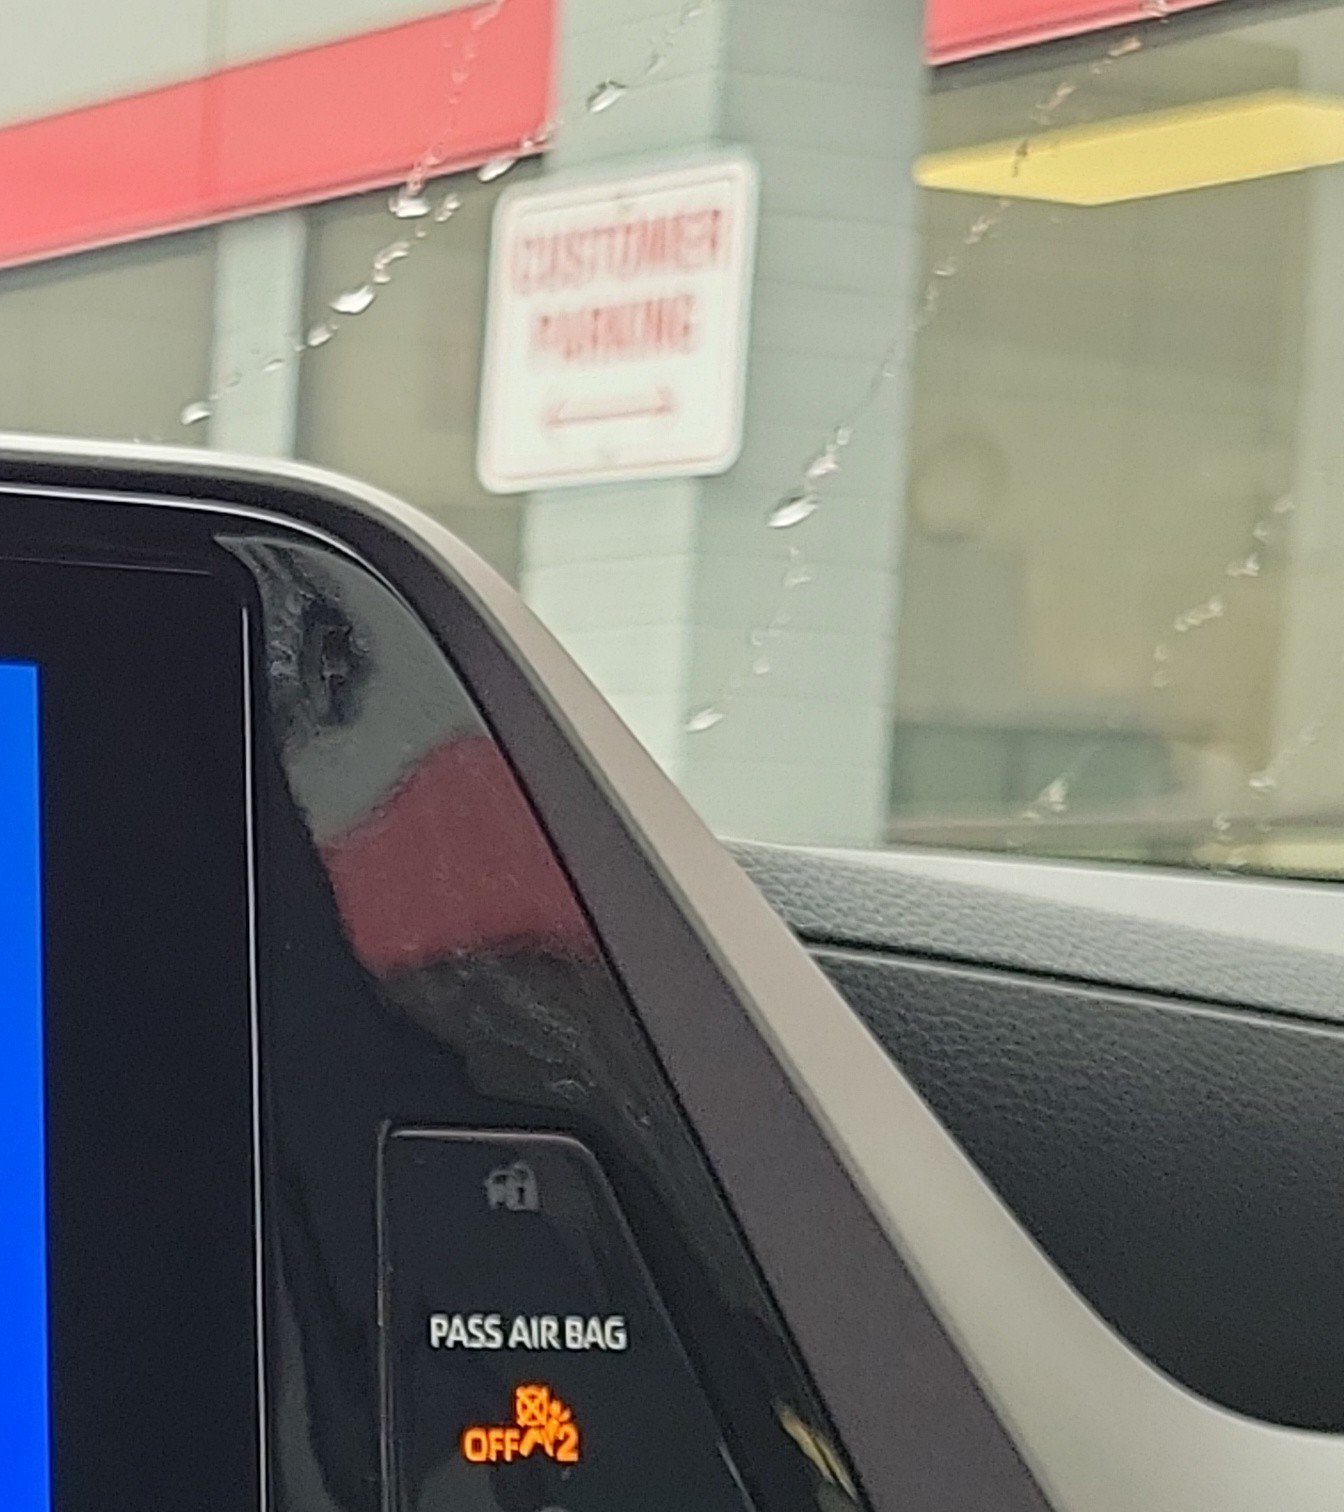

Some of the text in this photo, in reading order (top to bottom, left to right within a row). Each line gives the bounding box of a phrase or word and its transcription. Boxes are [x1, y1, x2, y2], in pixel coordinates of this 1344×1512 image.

[430, 1314, 627, 1350] PASS AIR BAG
[464, 1427, 521, 1462] OFF
